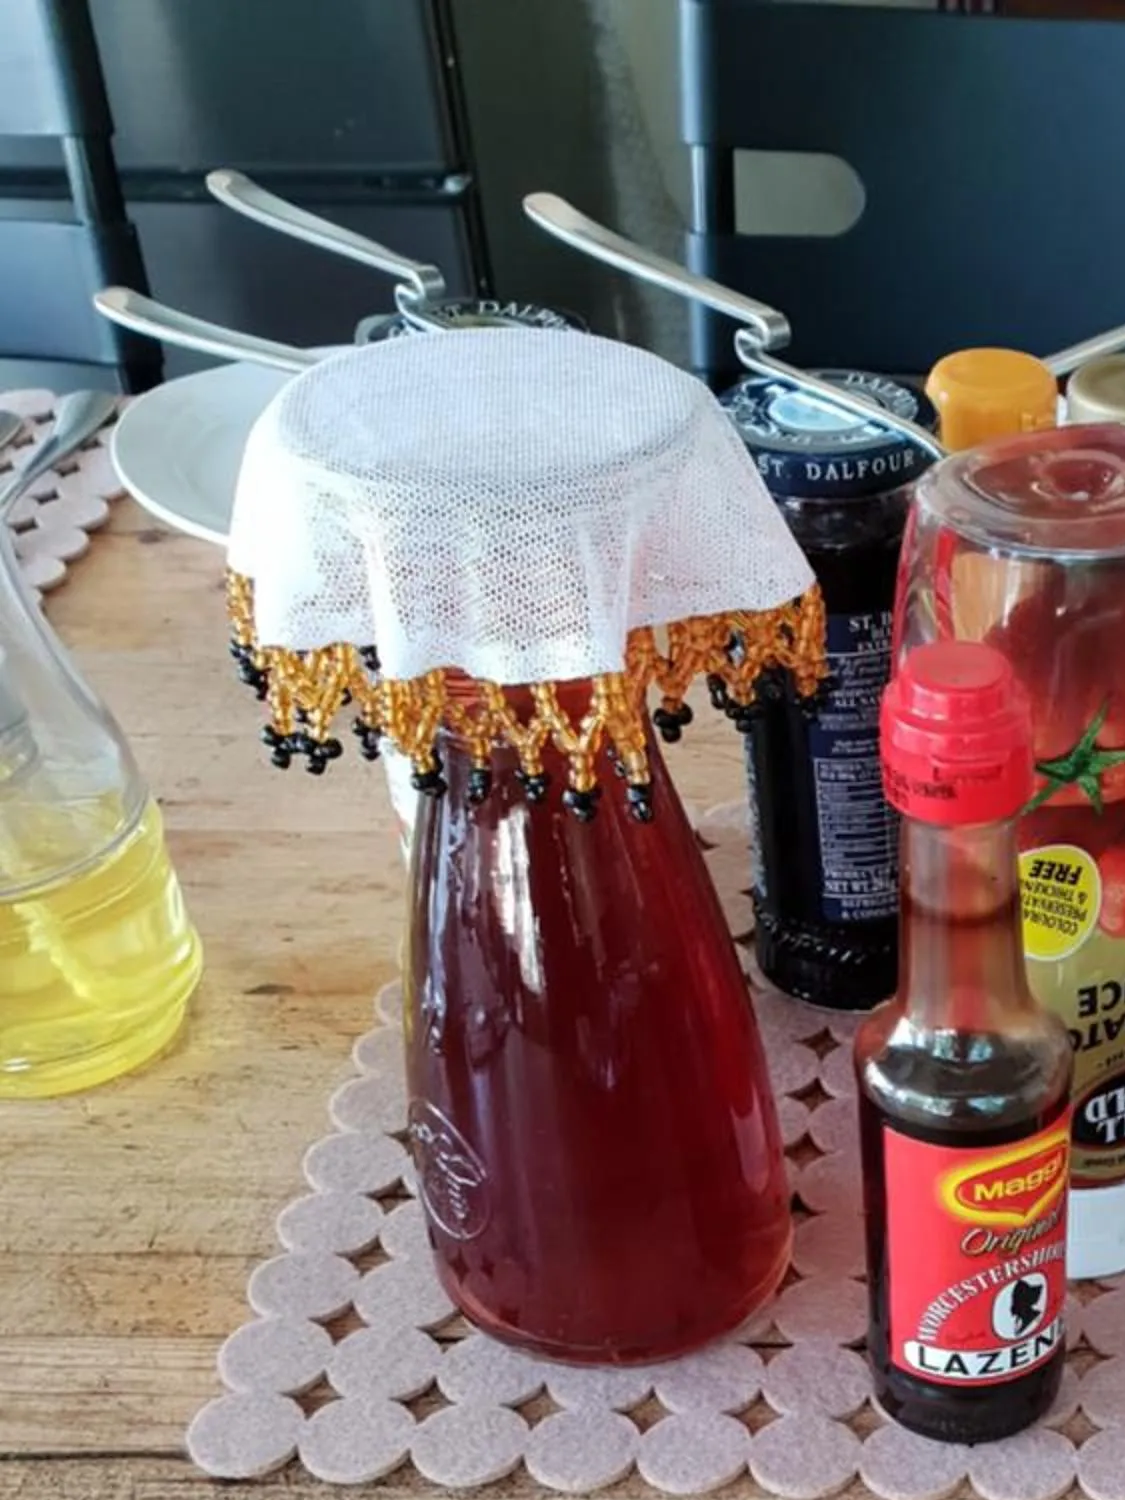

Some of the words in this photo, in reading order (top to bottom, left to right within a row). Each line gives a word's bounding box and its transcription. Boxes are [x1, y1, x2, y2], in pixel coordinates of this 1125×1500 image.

[806, 448, 914, 481] DALFOUR
[1029, 859, 1083, 886] FREE
[972, 1150, 1063, 1202] Maggi
